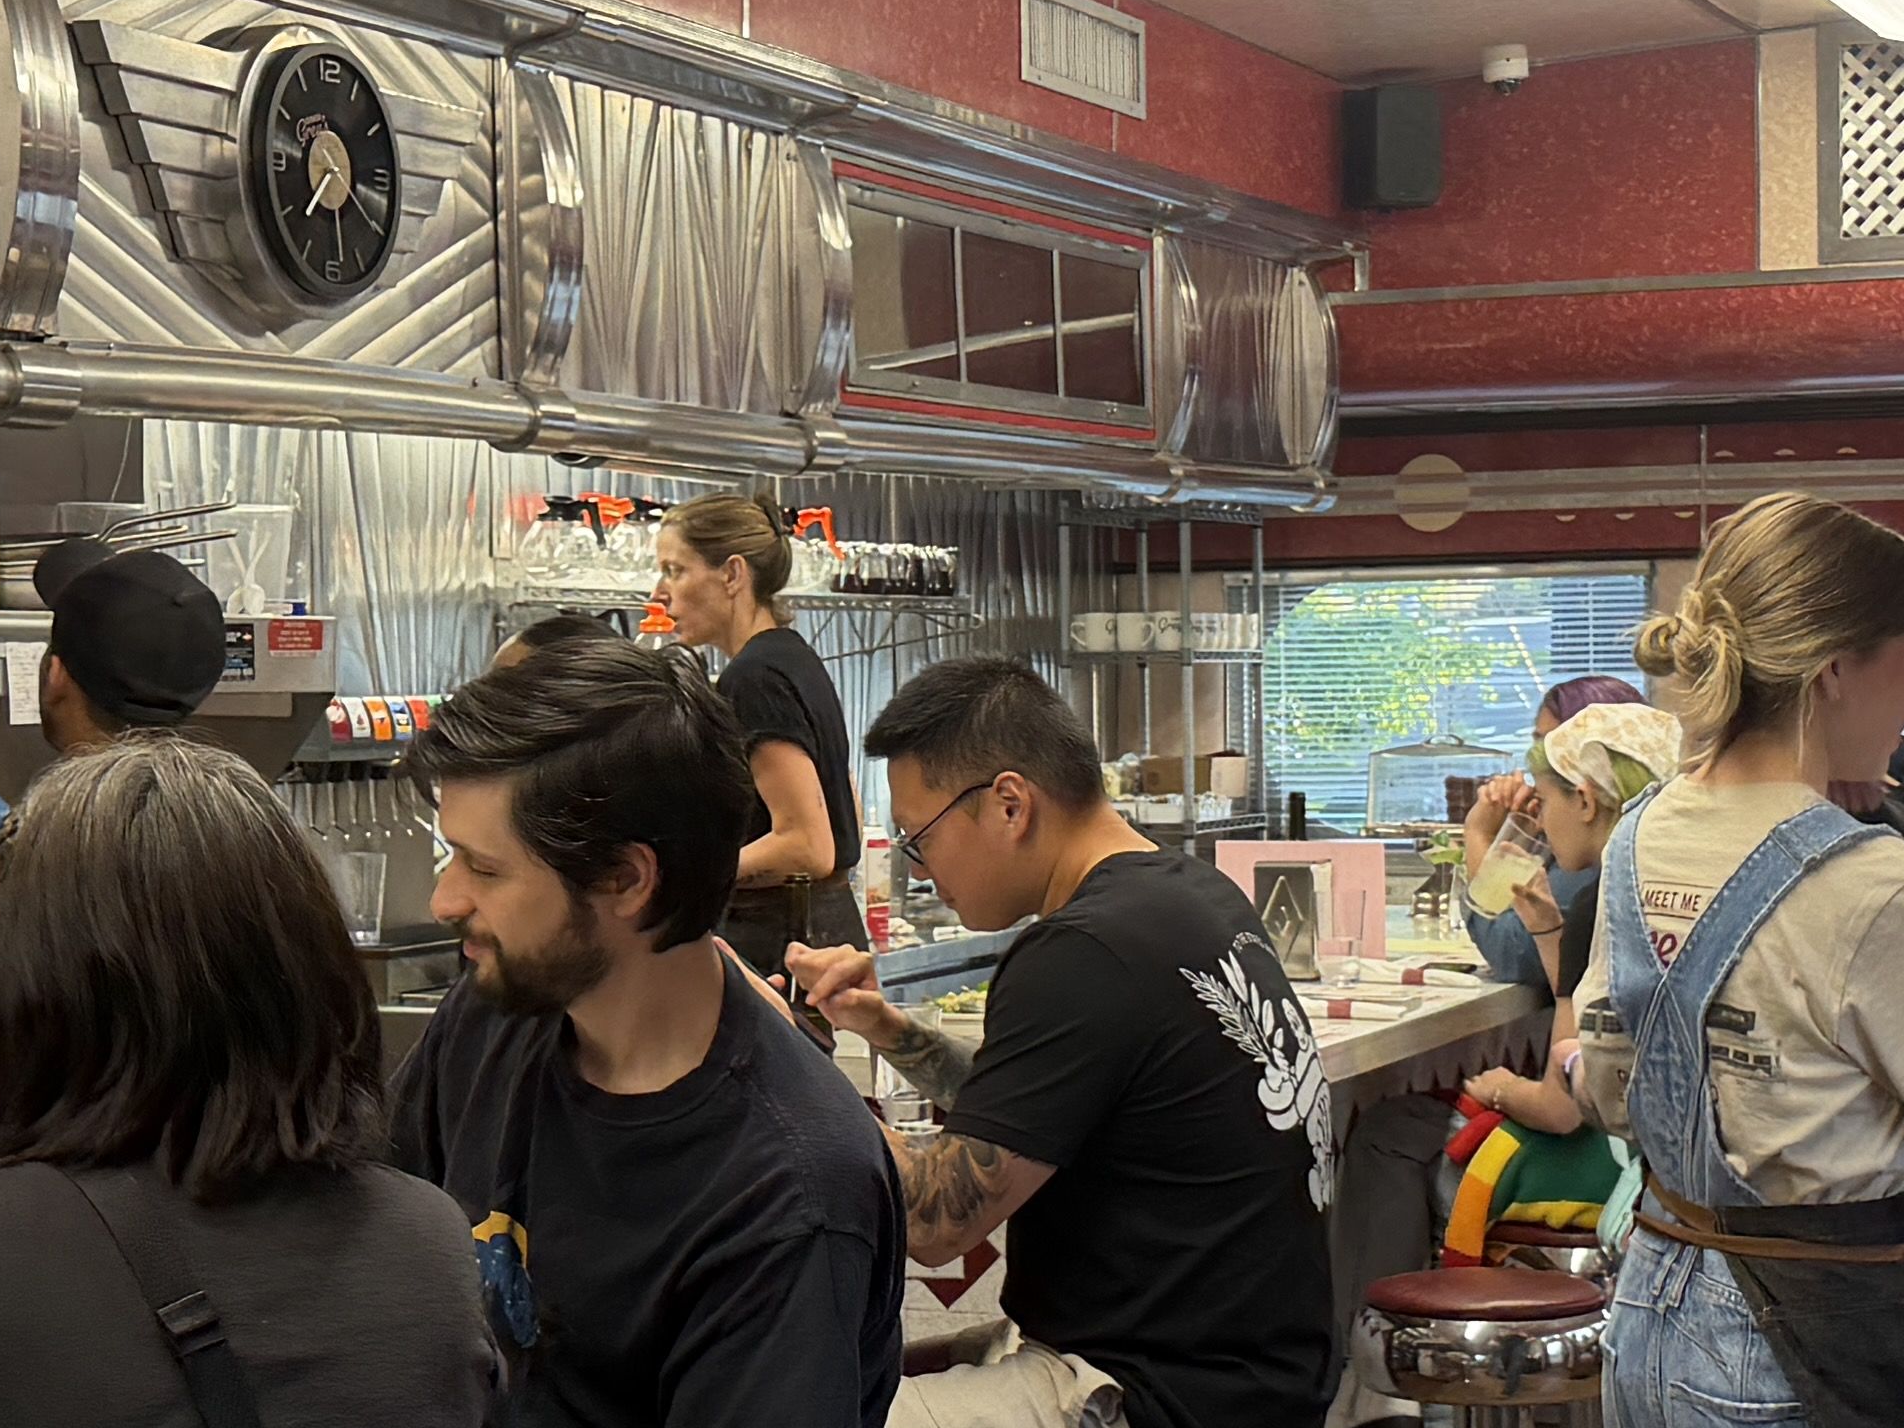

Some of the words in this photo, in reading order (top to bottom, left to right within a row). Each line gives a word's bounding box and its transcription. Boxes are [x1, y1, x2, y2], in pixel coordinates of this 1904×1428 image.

[319, 58, 341, 84] 12
[272, 149, 286, 172] 9
[374, 168, 390, 192] 3
[325, 260, 341, 282] 6
[1645, 889, 1678, 910] MEET
[1680, 893, 1702, 912] ME
